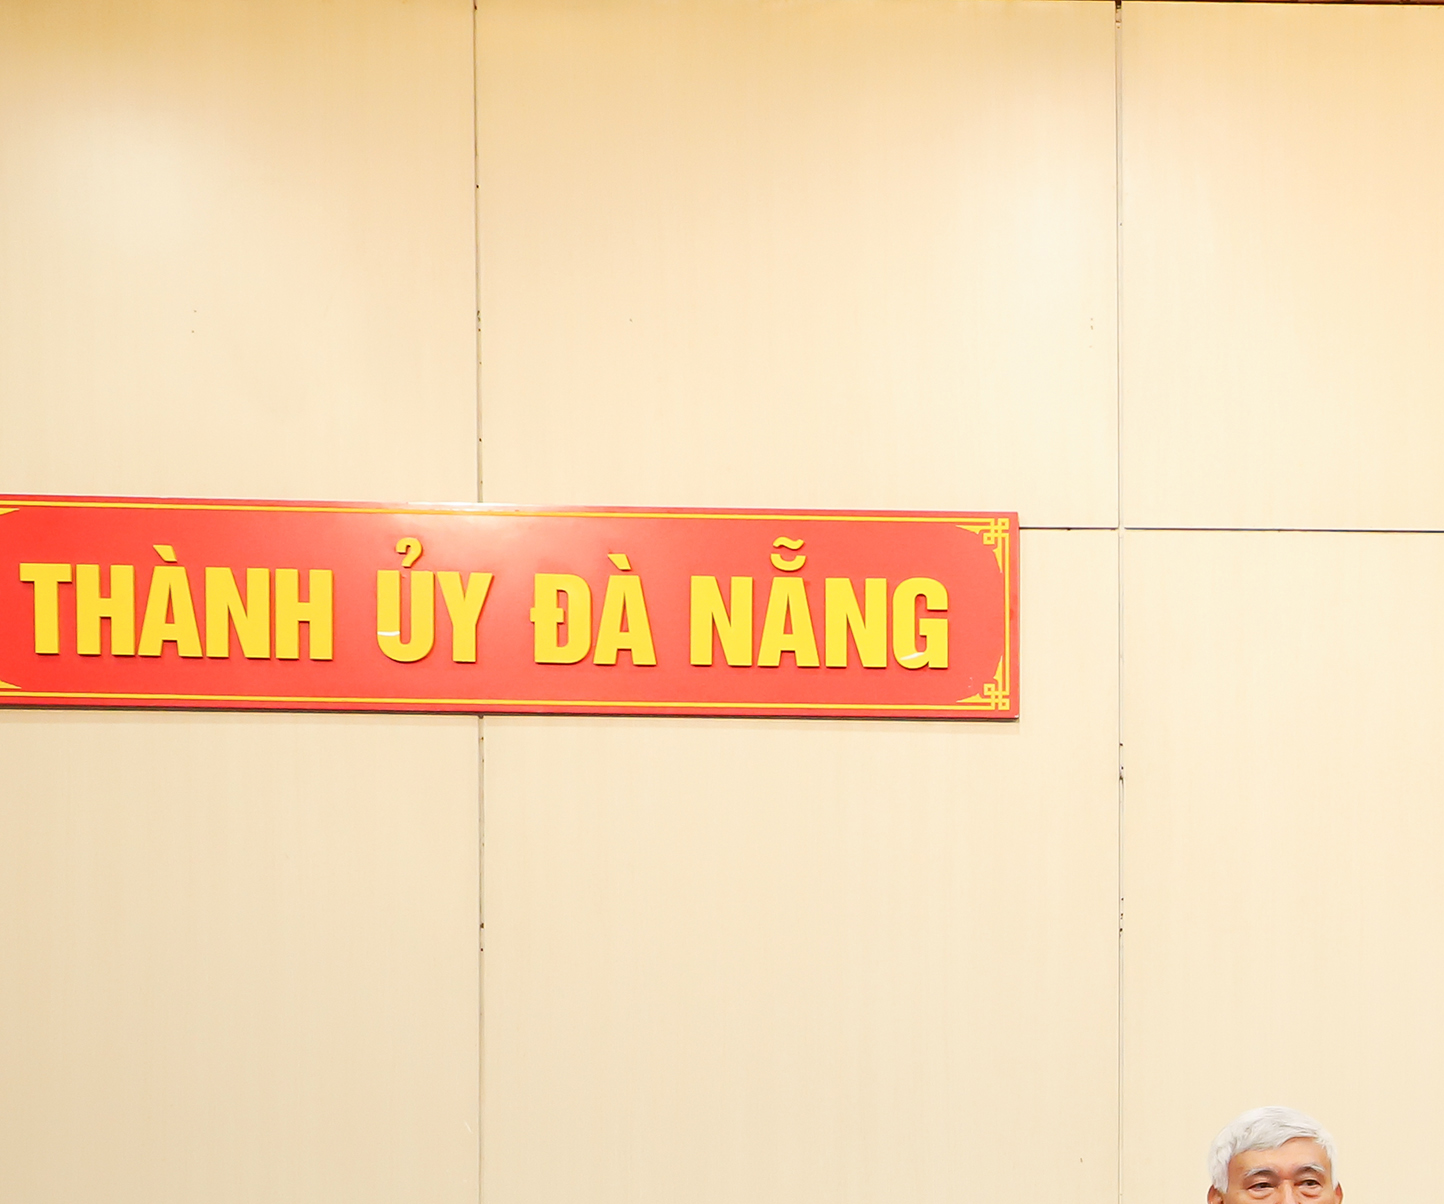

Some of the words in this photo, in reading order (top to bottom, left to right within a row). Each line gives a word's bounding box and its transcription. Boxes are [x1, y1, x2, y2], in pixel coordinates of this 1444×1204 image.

[19, 544, 334, 661] THÀNH
[376, 536, 493, 663] ỦY
[529, 552, 657, 666] ĐÀ
[689, 536, 950, 669] NẴNG
